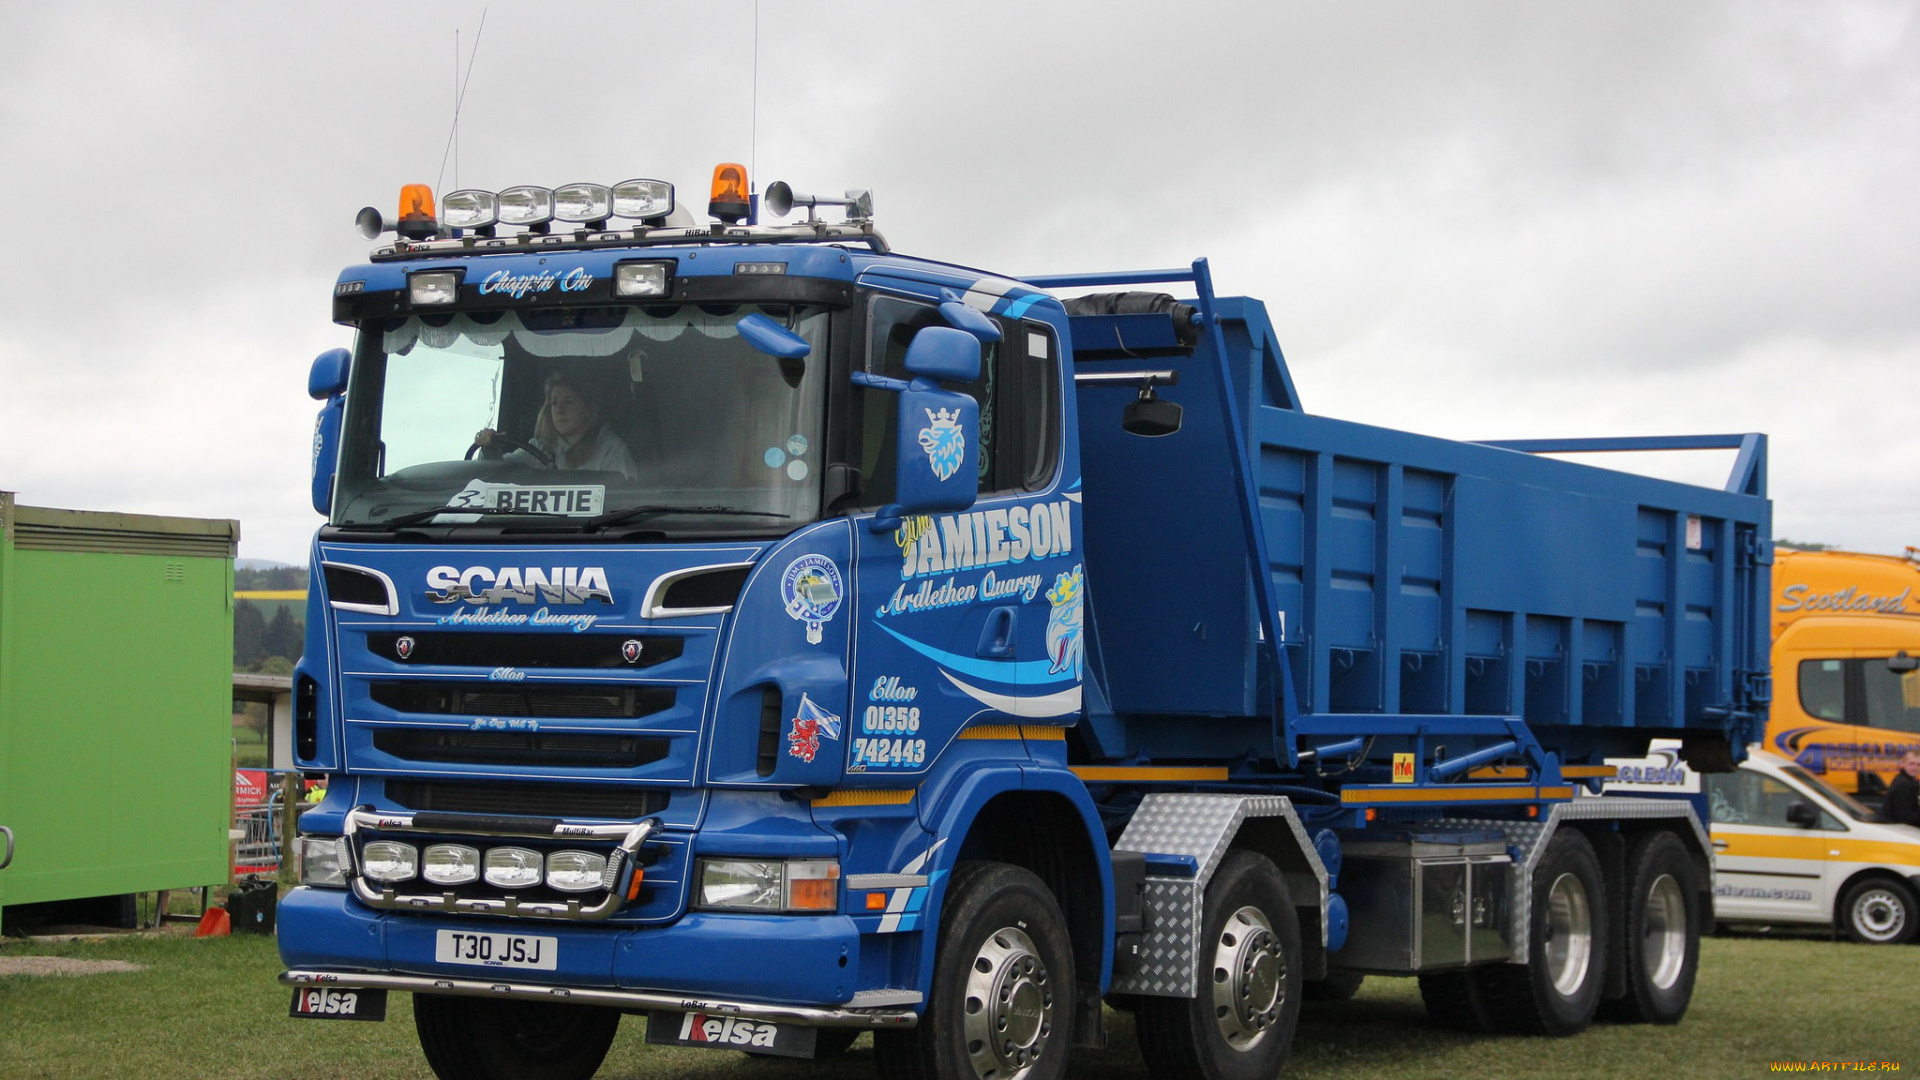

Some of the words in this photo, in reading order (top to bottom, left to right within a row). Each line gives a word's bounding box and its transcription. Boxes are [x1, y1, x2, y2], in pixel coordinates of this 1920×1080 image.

[684, 229, 711, 237] HiBar
[560, 266, 593, 293] On
[496, 490, 592, 512] BERTIE
[895, 515, 932, 558] Jim
[901, 501, 1072, 580] JAMIESON
[787, 566, 800, 581] JIM
[804, 558, 838, 581] JAMIESON
[425, 565, 615, 605] SCANIA
[876, 577, 978, 618] Ardlethen
[979, 570, 1042, 604] Quarry
[1777, 584, 1911, 613] Scotland
[437, 606, 530, 626] Ardlethen
[529, 606, 598, 632] Quarry
[488, 666, 527, 681] Ellon
[868, 675, 919, 702] Ellon
[863, 706, 921, 735] 01358
[853, 738, 926, 767] 742443
[378, 818, 403, 828] Kelsa
[562, 826, 595, 837] MultiBar
[452, 934, 492, 960] T30
[498, 937, 541, 964] JSJ
[315, 974, 338, 983] Kelsa
[297, 987, 358, 1014] Kelsa
[680, 999, 708, 1010] LoBar
[678, 1012, 778, 1047] Kelsa
